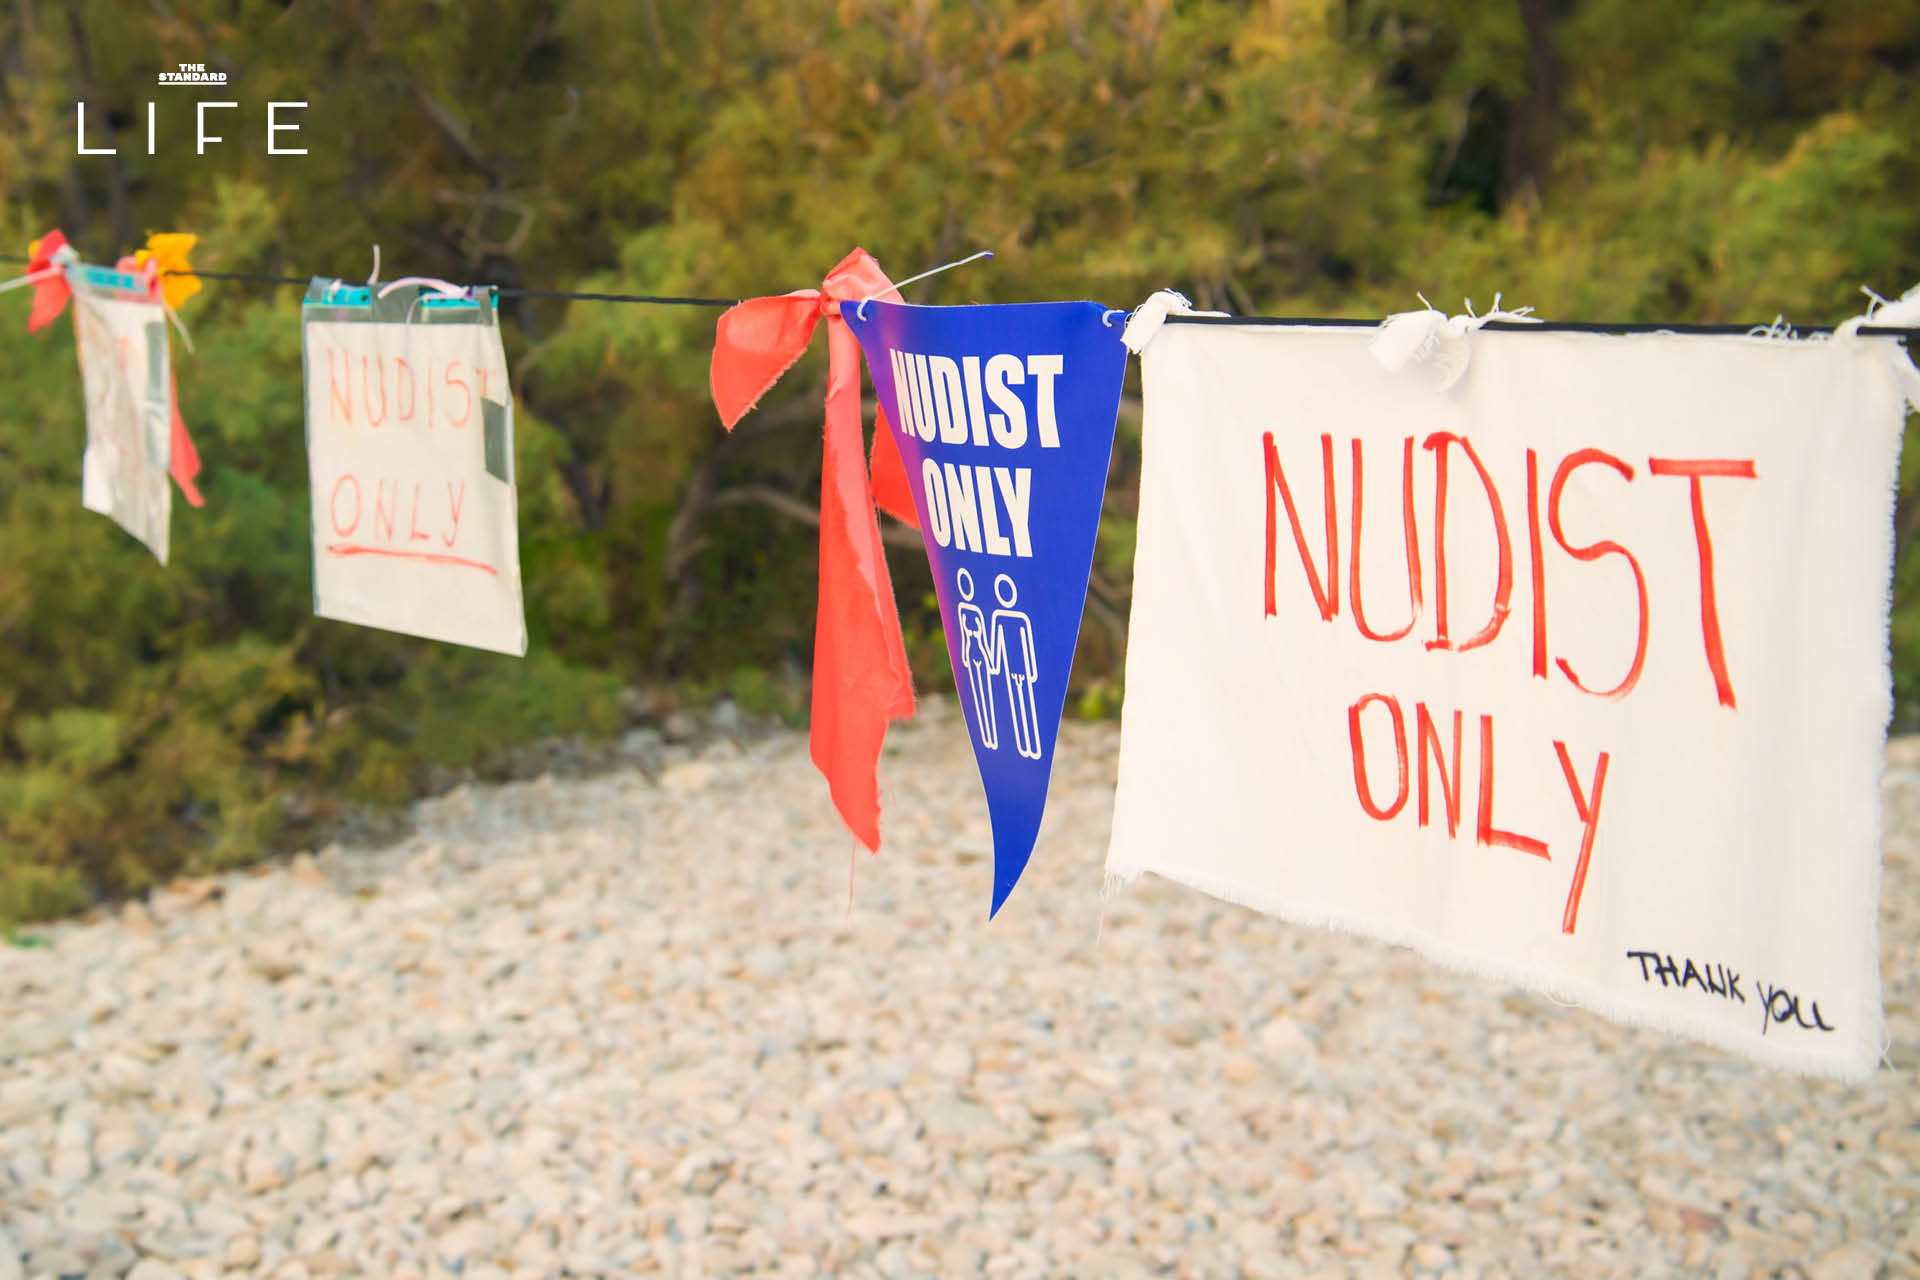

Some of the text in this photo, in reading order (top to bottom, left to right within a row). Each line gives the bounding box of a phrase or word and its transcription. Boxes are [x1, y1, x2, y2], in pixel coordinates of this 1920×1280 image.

[889, 348, 1064, 449] NUDIST
[330, 475, 465, 548] ONLY
[922, 457, 1033, 558] ONLY
[1262, 430, 1757, 710] NUDIST
[1348, 692, 1610, 935] ONLY
[1627, 951, 1834, 1035] THANK YOU
